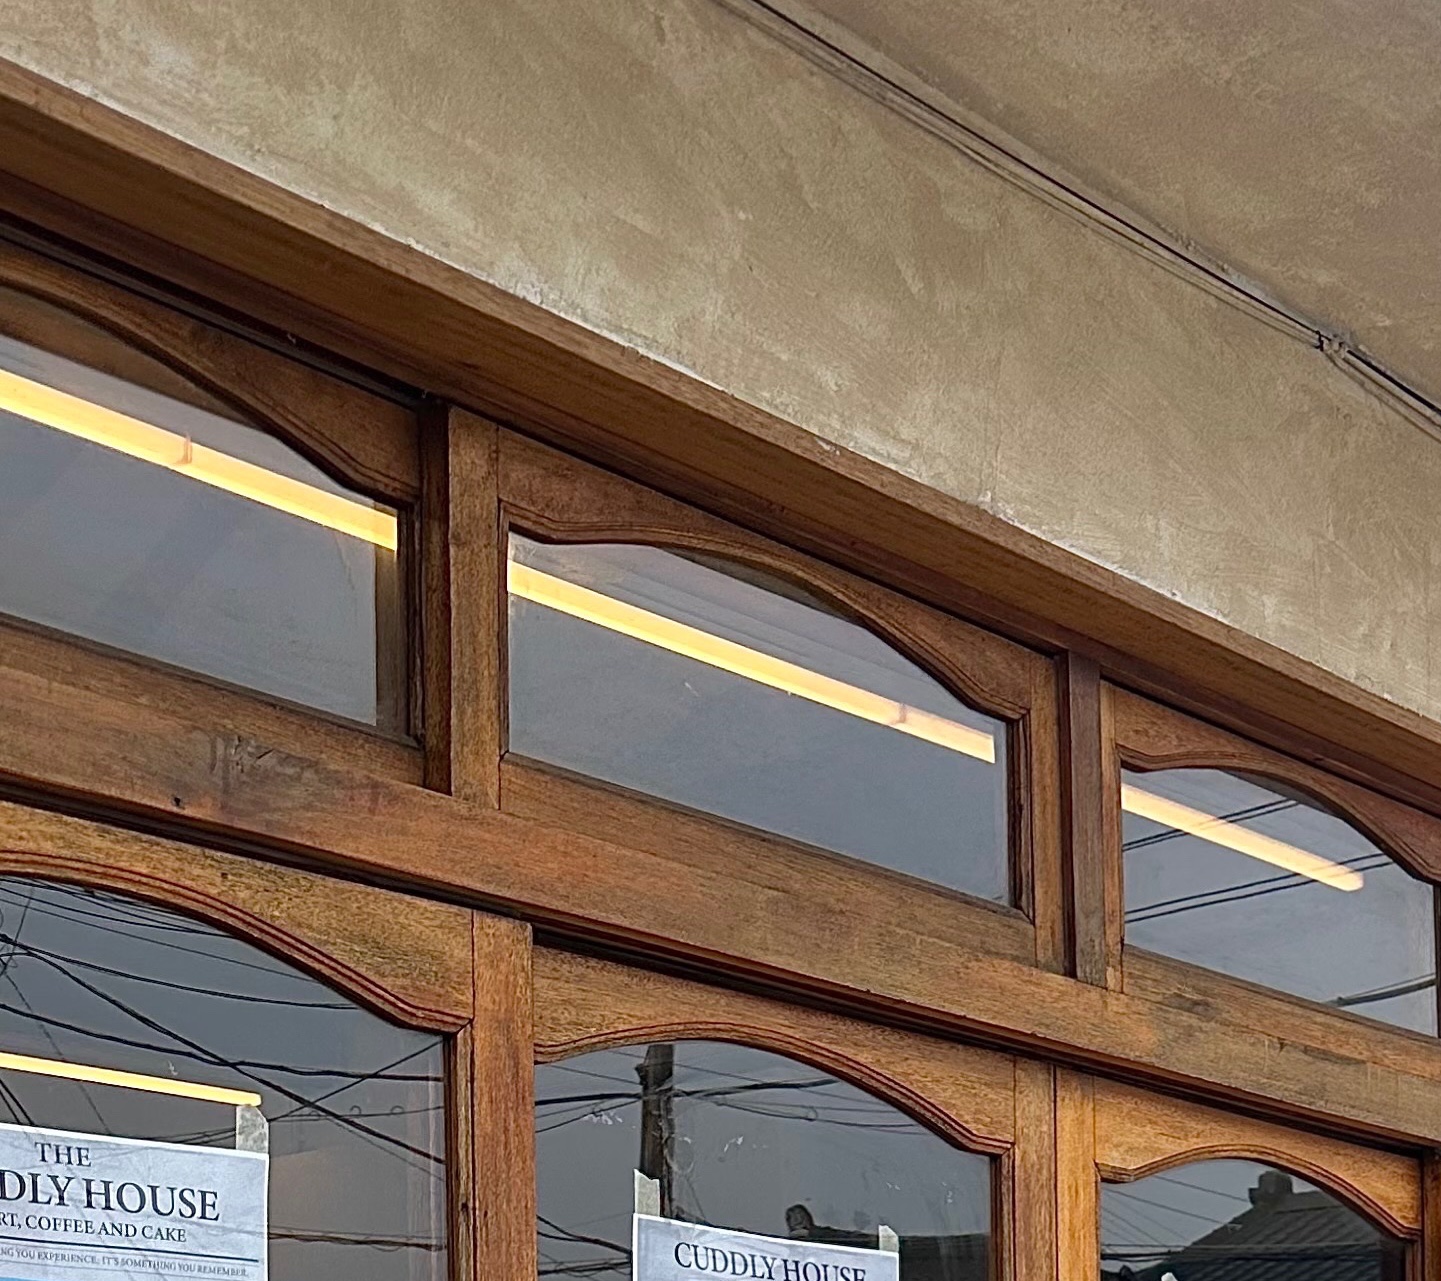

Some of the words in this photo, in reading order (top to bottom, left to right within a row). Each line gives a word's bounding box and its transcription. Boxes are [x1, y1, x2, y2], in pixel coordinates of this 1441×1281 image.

[35, 1142, 92, 1167] THE
[0, 1169, 76, 1206] DLY
[82, 1178, 220, 1222] HOUSE
[26, 1215, 96, 1234] COFFEE
[98, 1222, 136, 1238] AND
[142, 1226, 186, 1242] CAKE
[16, 1249, 34, 1260] YOU
[102, 1256, 119, 1266] IT'S
[120, 1258, 176, 1272] SOMETHING
[178, 1263, 196, 1273] YOU
[674, 1242, 776, 1280] CUDDLY
